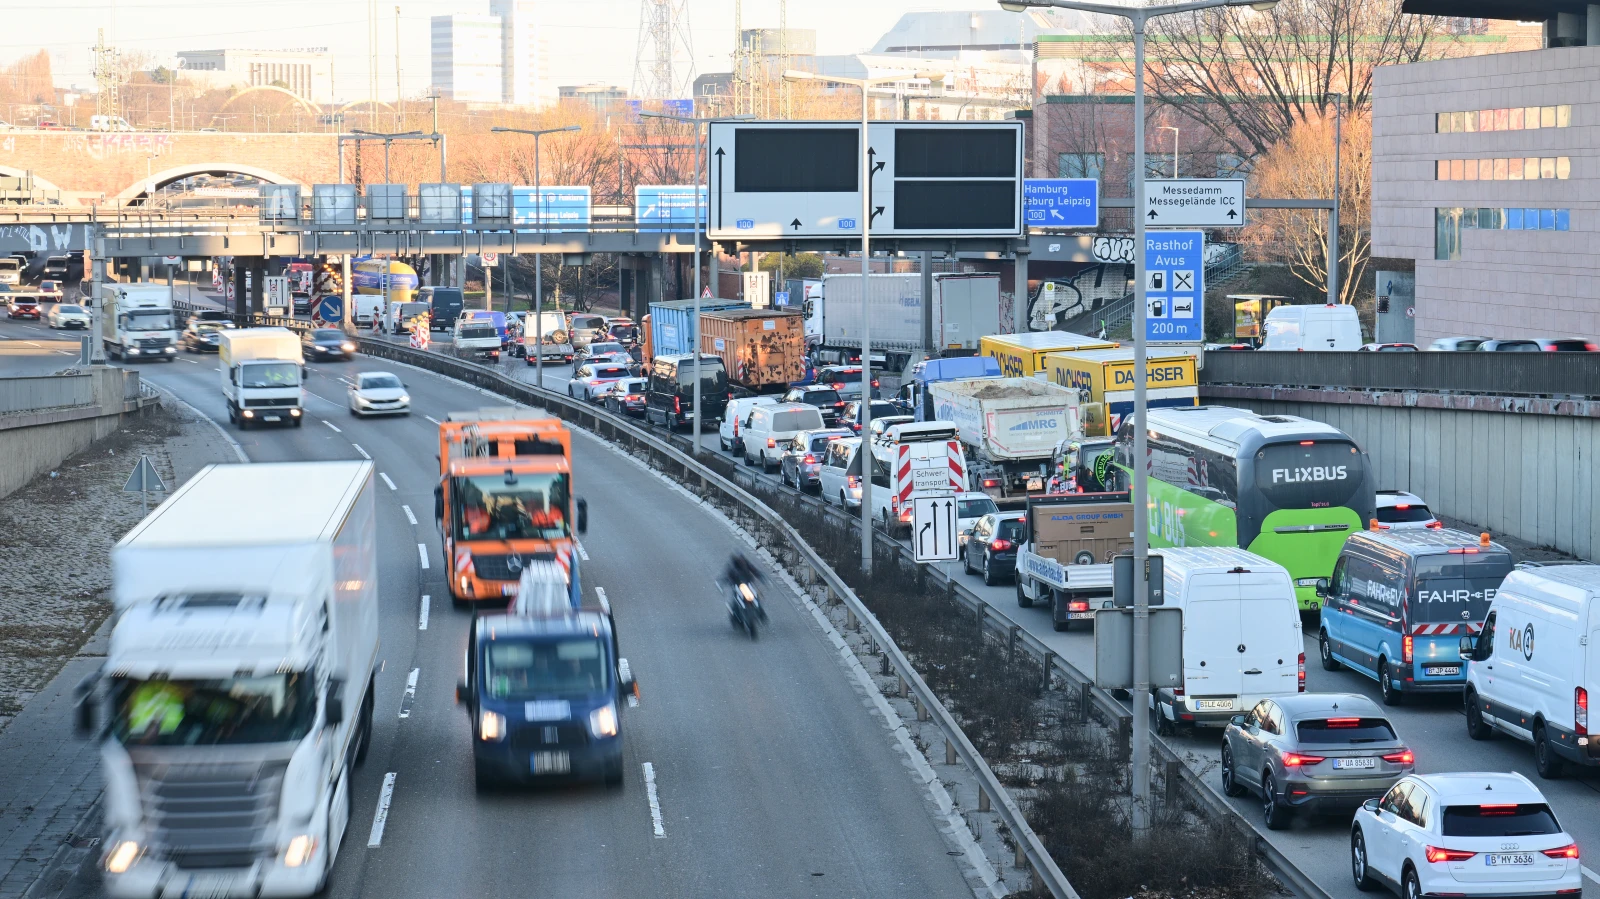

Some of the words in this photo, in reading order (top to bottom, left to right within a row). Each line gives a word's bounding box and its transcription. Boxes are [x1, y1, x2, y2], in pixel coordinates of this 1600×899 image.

[1024, 184, 1068, 195] Hamburg
[1163, 186, 1222, 194] Messedamm
[1058, 196, 1091, 208] Leipzig
[1149, 196, 1216, 208] Messegelände
[1220, 196, 1236, 205] ICC
[738, 220, 752, 228] 100
[840, 220, 852, 228] 100
[1146, 240, 1193, 250] Rasthof
[1155, 254, 1185, 266] Avus
[1152, 322, 1174, 334] 200
[1176, 325, 1188, 334] m
[1115, 366, 1184, 384] DAHSER
[1028, 418, 1057, 430] MRG
[916, 479, 948, 487] transport
[1514, 854, 1532, 864] 3636
